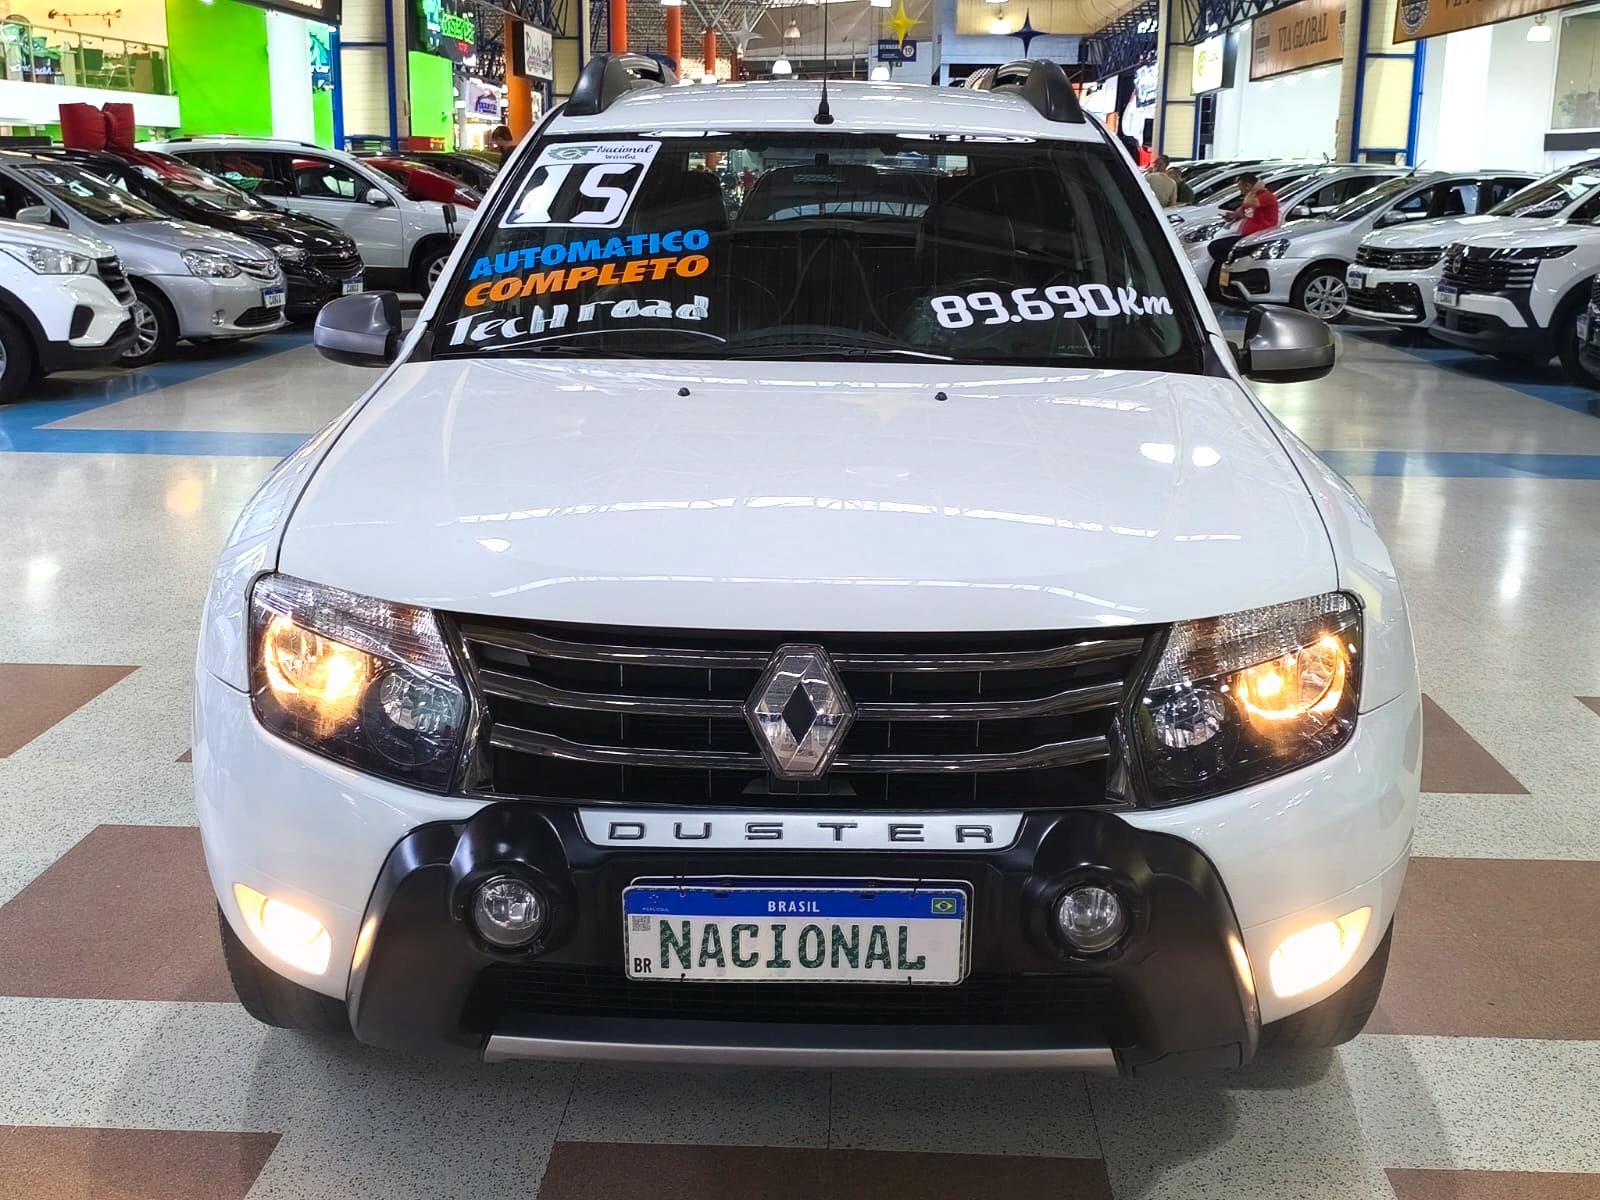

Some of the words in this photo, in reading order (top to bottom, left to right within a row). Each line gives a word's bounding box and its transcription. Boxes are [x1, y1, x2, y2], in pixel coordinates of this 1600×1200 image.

[1278, 25, 1292, 52] VIA
[1293, 12, 1329, 49] GLOBAL
[596, 144, 653, 153] Nacional
[513, 163, 637, 224] 15
[469, 229, 710, 280] AUTOMATICO
[464, 254, 710, 307] COMPLETO
[607, 821, 995, 844] DUSTER
[767, 900, 821, 913] BRASIL
[659, 919, 926, 971] NACIONAL
[633, 957, 652, 974] BR
